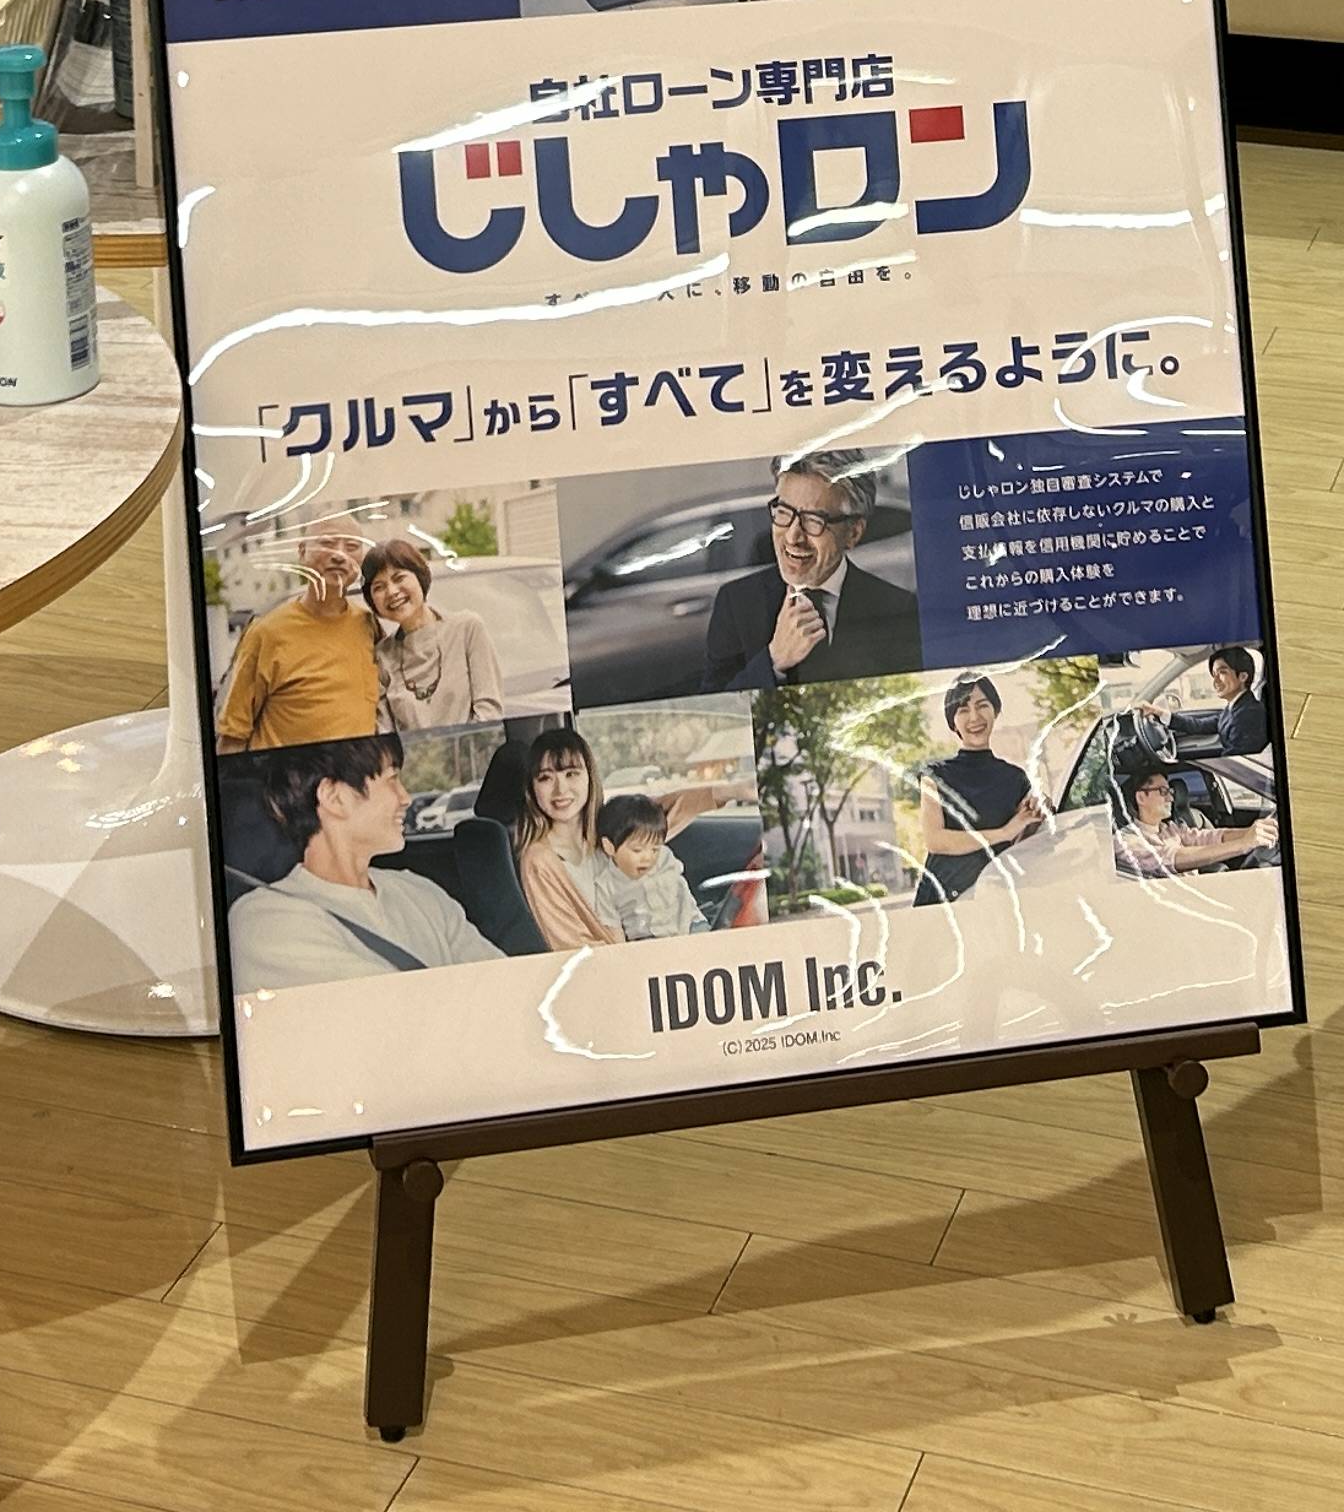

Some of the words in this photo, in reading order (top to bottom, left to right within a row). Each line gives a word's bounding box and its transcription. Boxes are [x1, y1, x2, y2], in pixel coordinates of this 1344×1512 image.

[398, 99, 1032, 275] じしゃロン
[958, 468, 1164, 500] じしゃロン独自審査システムで
[959, 495, 1215, 531] 信販会社に依存しないクルマの購入と
[965, 562, 1116, 591] これからの購入体験を
[966, 587, 1185, 622] 理想に近づけることができます。
[647, 960, 788, 1033] IDOM
[805, 956, 903, 1013] Inc.
[780, 1031, 818, 1048] IDOM
